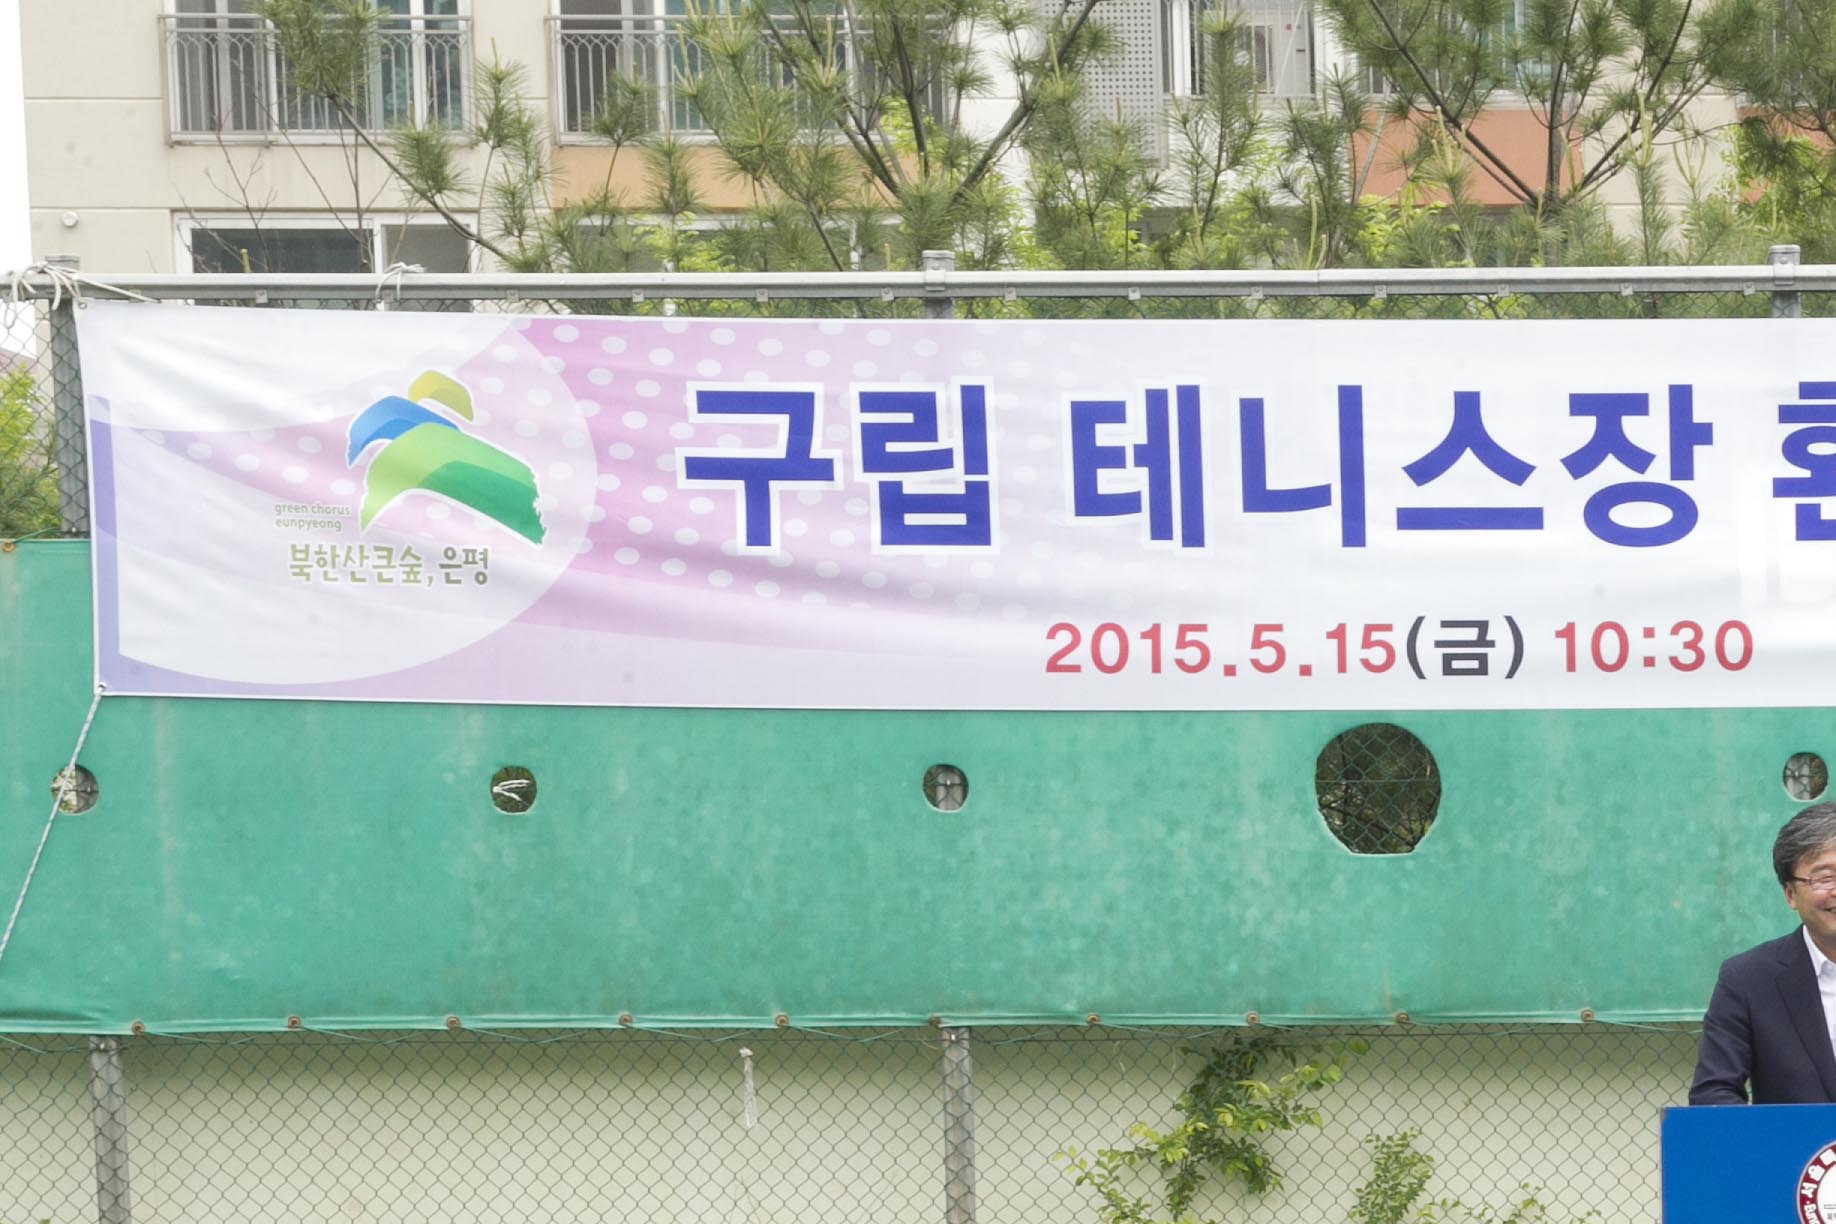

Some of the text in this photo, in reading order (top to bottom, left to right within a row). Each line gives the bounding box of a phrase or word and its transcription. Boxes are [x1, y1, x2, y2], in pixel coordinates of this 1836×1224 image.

[684, 383, 992, 548] 구립
[1069, 383, 1713, 548] 테니스장
[274, 503, 351, 516] green chorus
[275, 518, 342, 532] eunpyeong
[289, 543, 489, 587] 북한산큰숲, 은평
[1044, 615, 1753, 680] 2015.5.15(금) 10:30
